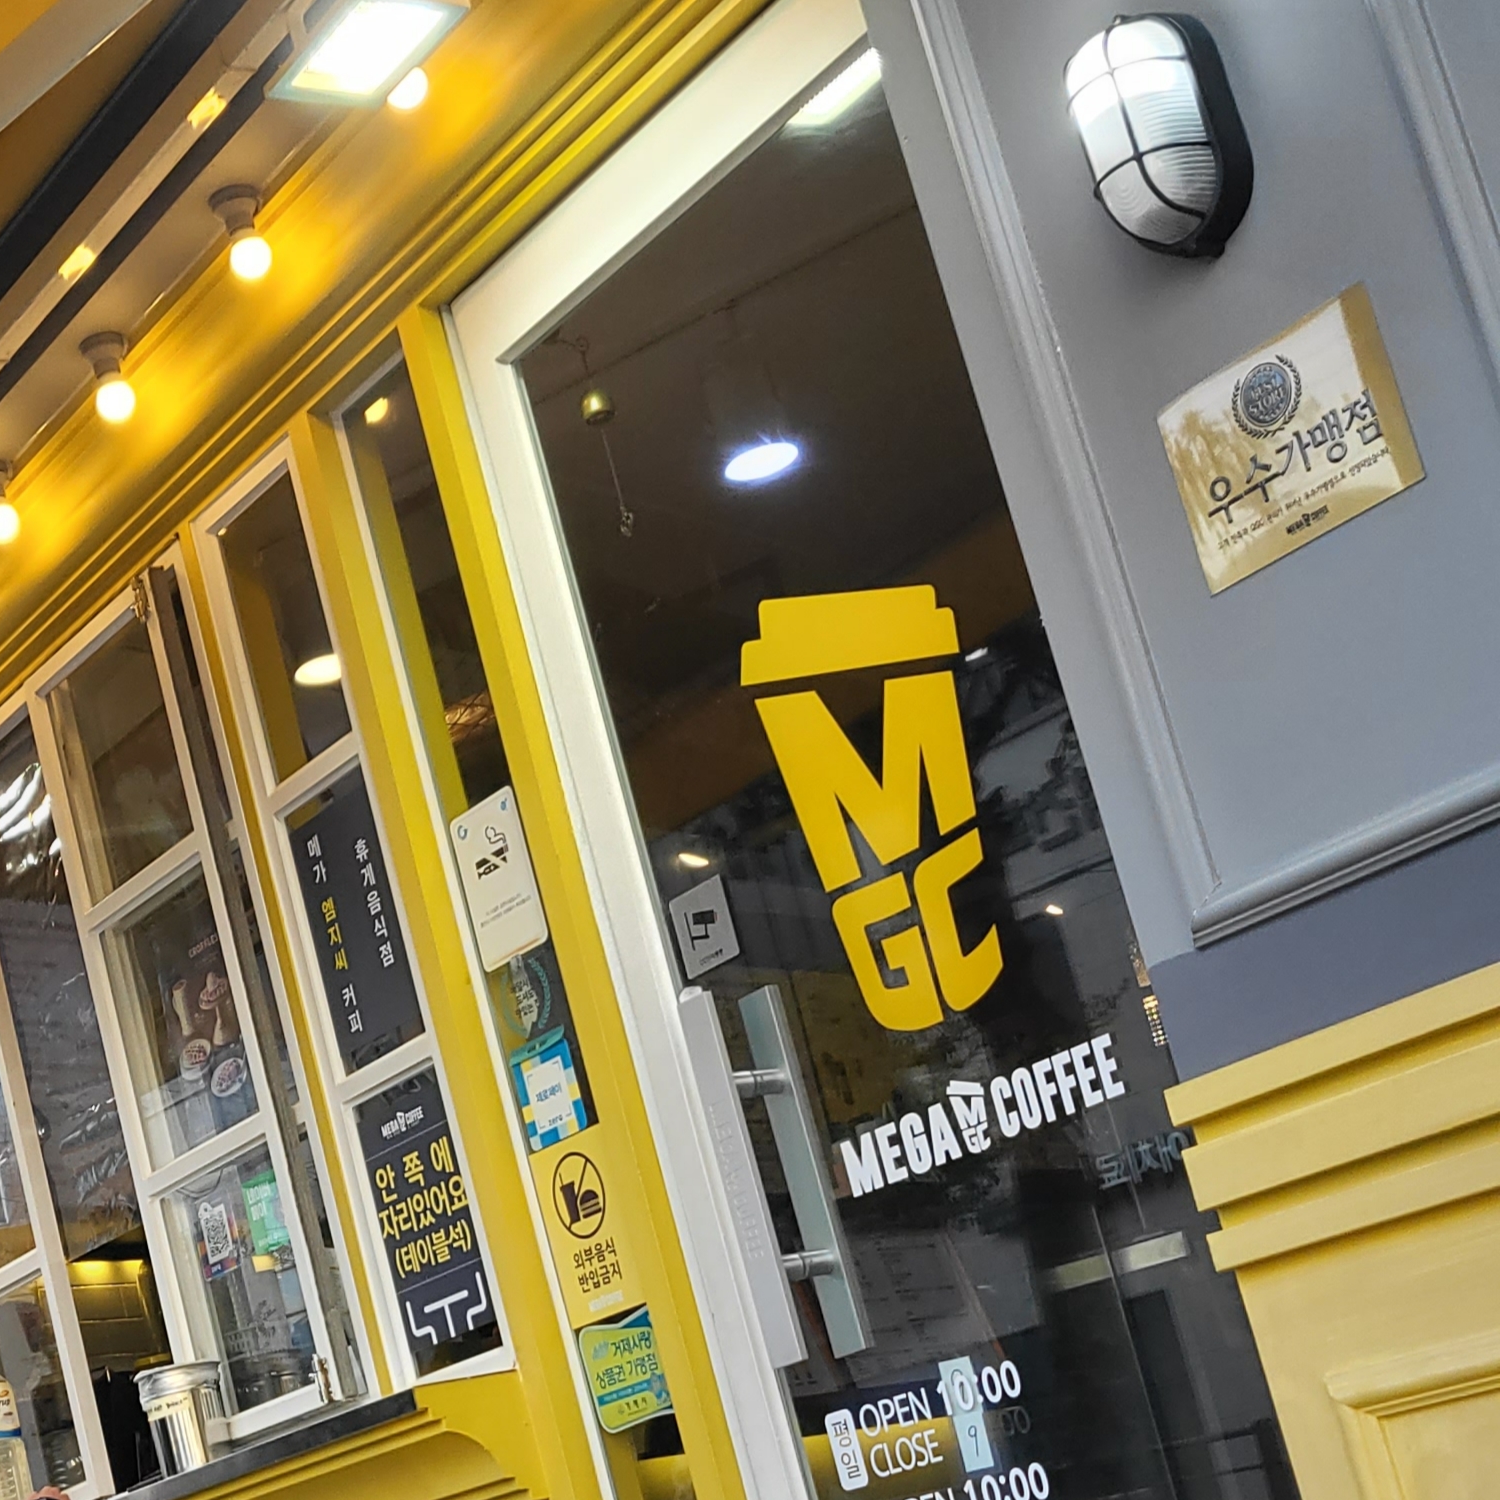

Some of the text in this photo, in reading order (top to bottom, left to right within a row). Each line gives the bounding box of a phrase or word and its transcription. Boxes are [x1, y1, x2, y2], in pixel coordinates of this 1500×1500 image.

[1207, 388, 1385, 524] 우수가맹점
[353, 837, 396, 969] 휴게음식점
[839, 1033, 1126, 1198] MEGA COFFEE
[377, 1175, 470, 1240] 자리있어요
[394, 1218, 472, 1279] (테이블석)
[573, 1237, 618, 1271] 외부음식
[577, 1260, 624, 1294] 반입금지
[859, 1387, 932, 1437] OPEN
[830, 1417, 862, 1480] 평일
[869, 1428, 944, 1479] CLOSE
